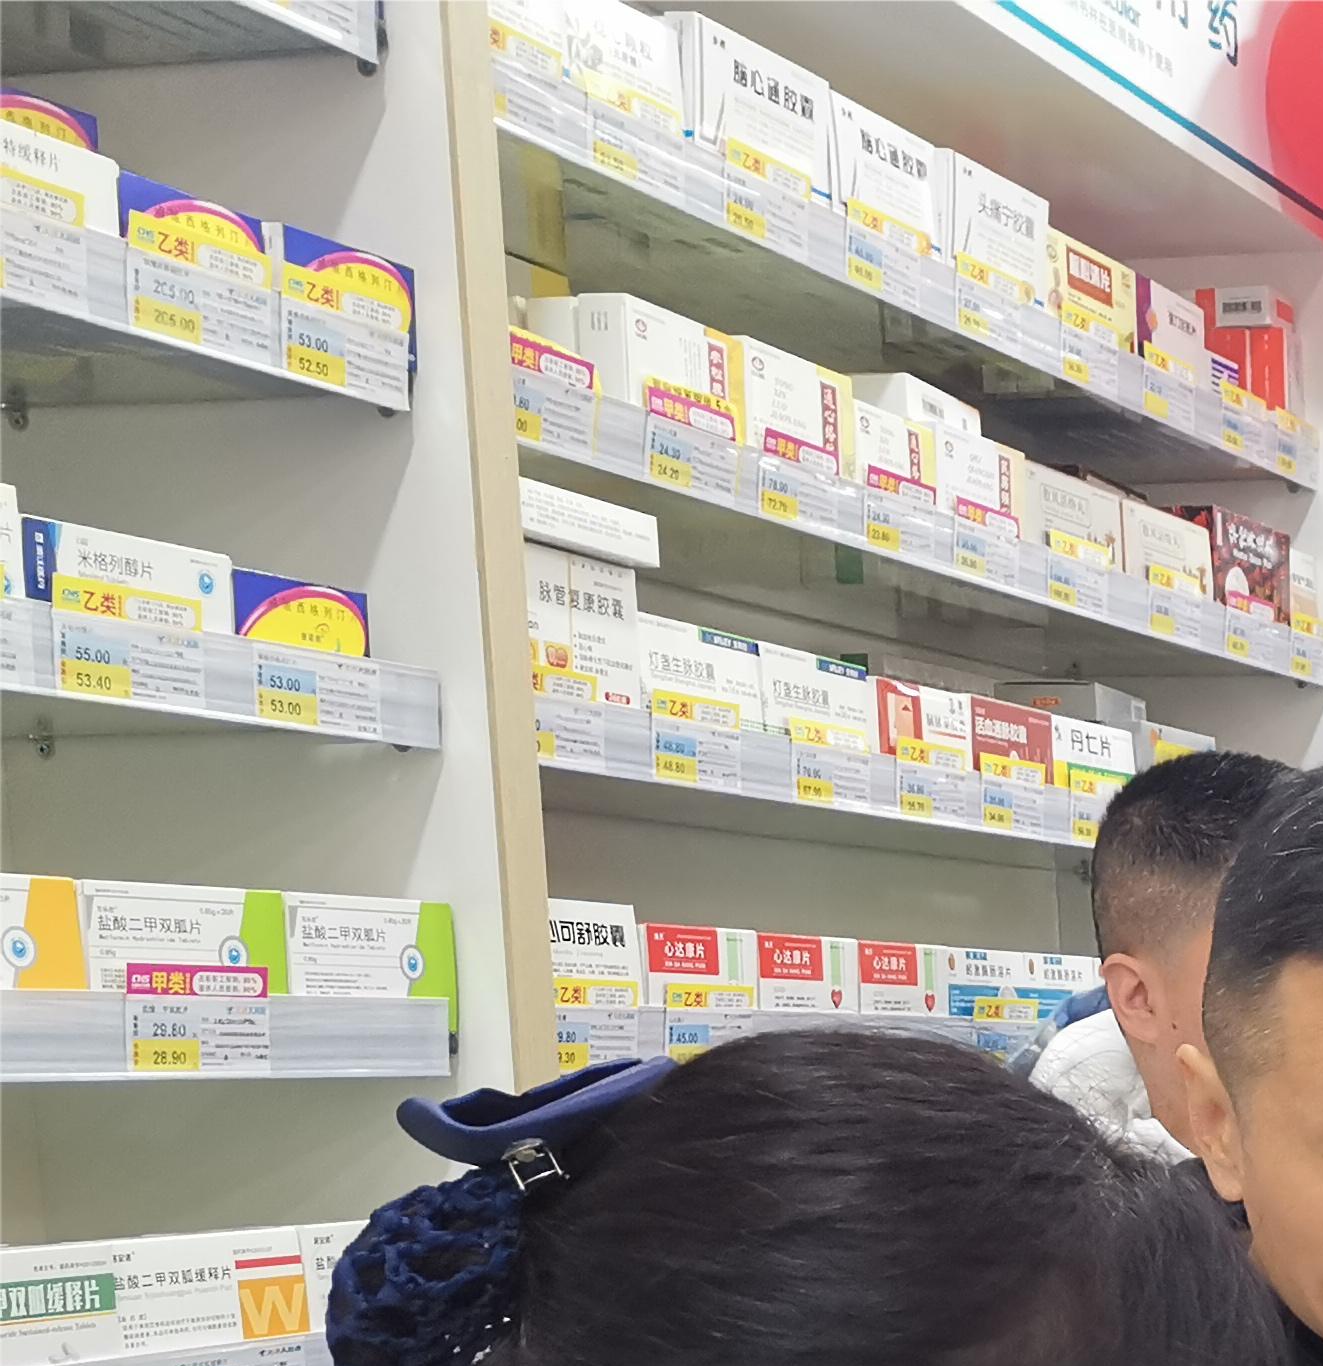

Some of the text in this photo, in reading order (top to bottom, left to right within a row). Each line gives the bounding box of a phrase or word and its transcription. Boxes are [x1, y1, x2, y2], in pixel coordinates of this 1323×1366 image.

[157, 231, 189, 262] 乙类
[305, 281, 336, 309] 乙类
[298, 333, 329, 354] 53.00
[298, 357, 329, 378] 52.50
[76, 548, 154, 581] 米格列醇片
[83, 590, 117, 617] 乙类
[75, 646, 111, 665] 55.00
[76, 672, 112, 691] 53.40
[269, 674, 301, 692] 53.00
[270, 700, 302, 716] 53.00
[1070, 728, 1112, 759] 丹七片
[97, 914, 202, 935] 盐酸二甲双胍片
[301, 924, 387, 943] 盐酸二甲双胍片
[664, 940, 706, 959] 心达康片
[773, 949, 811, 965] 心达康片
[152, 971, 185, 994] 甲类
[675, 1032, 699, 1044] 45.00
[114, 1266, 232, 1291] 盐酸二甲双胍缓释片
[242, 1284, 306, 1336] W
